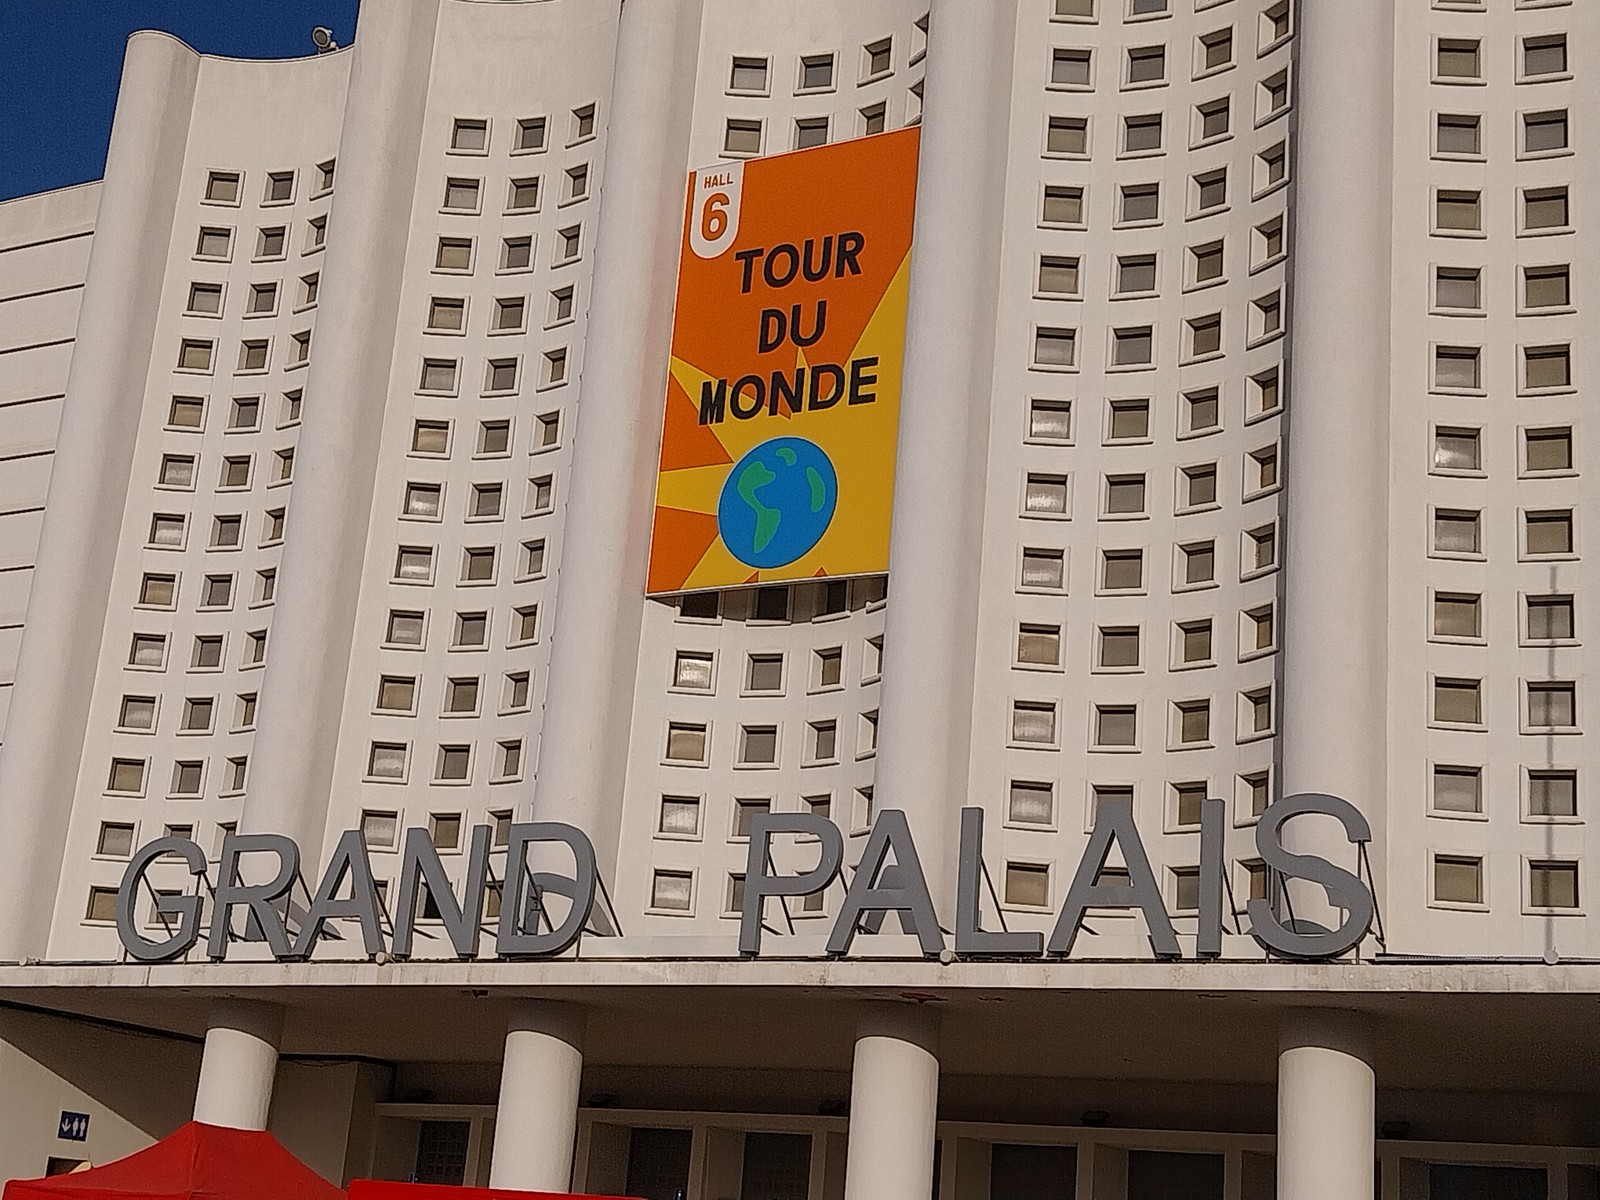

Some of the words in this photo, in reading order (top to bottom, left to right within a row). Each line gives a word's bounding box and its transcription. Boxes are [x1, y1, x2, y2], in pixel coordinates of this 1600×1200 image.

[703, 172, 734, 189] HALL
[701, 192, 730, 241] 6
[735, 231, 865, 294] TOUR
[758, 300, 827, 354] DU
[698, 356, 879, 426] MONDE
[115, 822, 597, 961] GRAND
[738, 793, 1374, 960] PALAIS
